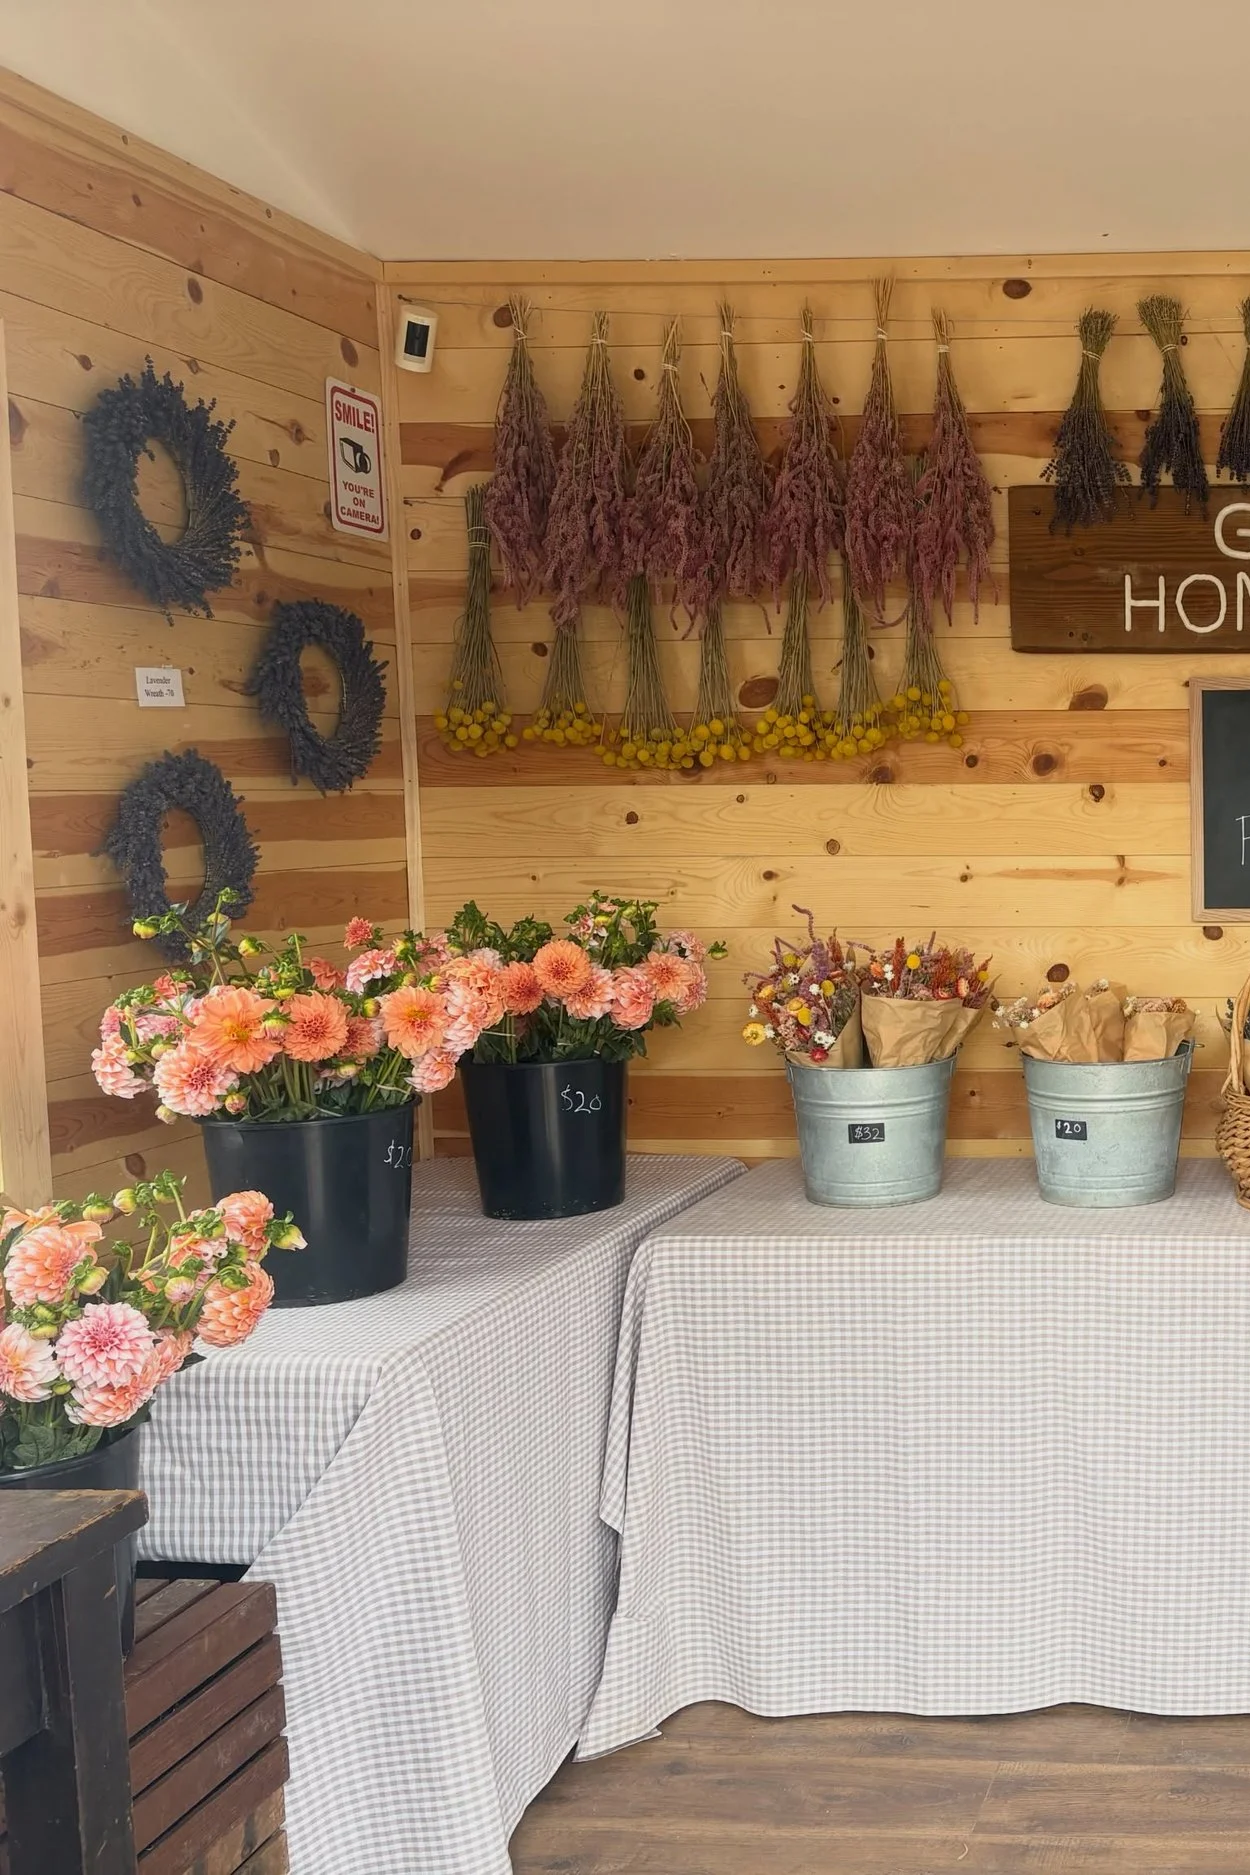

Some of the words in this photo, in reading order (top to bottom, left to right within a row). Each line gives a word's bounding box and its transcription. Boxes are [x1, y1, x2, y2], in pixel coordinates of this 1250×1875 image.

[335, 400, 375, 434] SMILE!
[342, 480, 375, 499] YOU'RE
[352, 497, 366, 509] ON
[340, 506, 380, 525] CAMERA!
[146, 676, 171, 684] Lavender
[560, 1084, 602, 1114] $20
[854, 1125, 884, 1140] $32
[1056, 1121, 1082, 1134] $20
